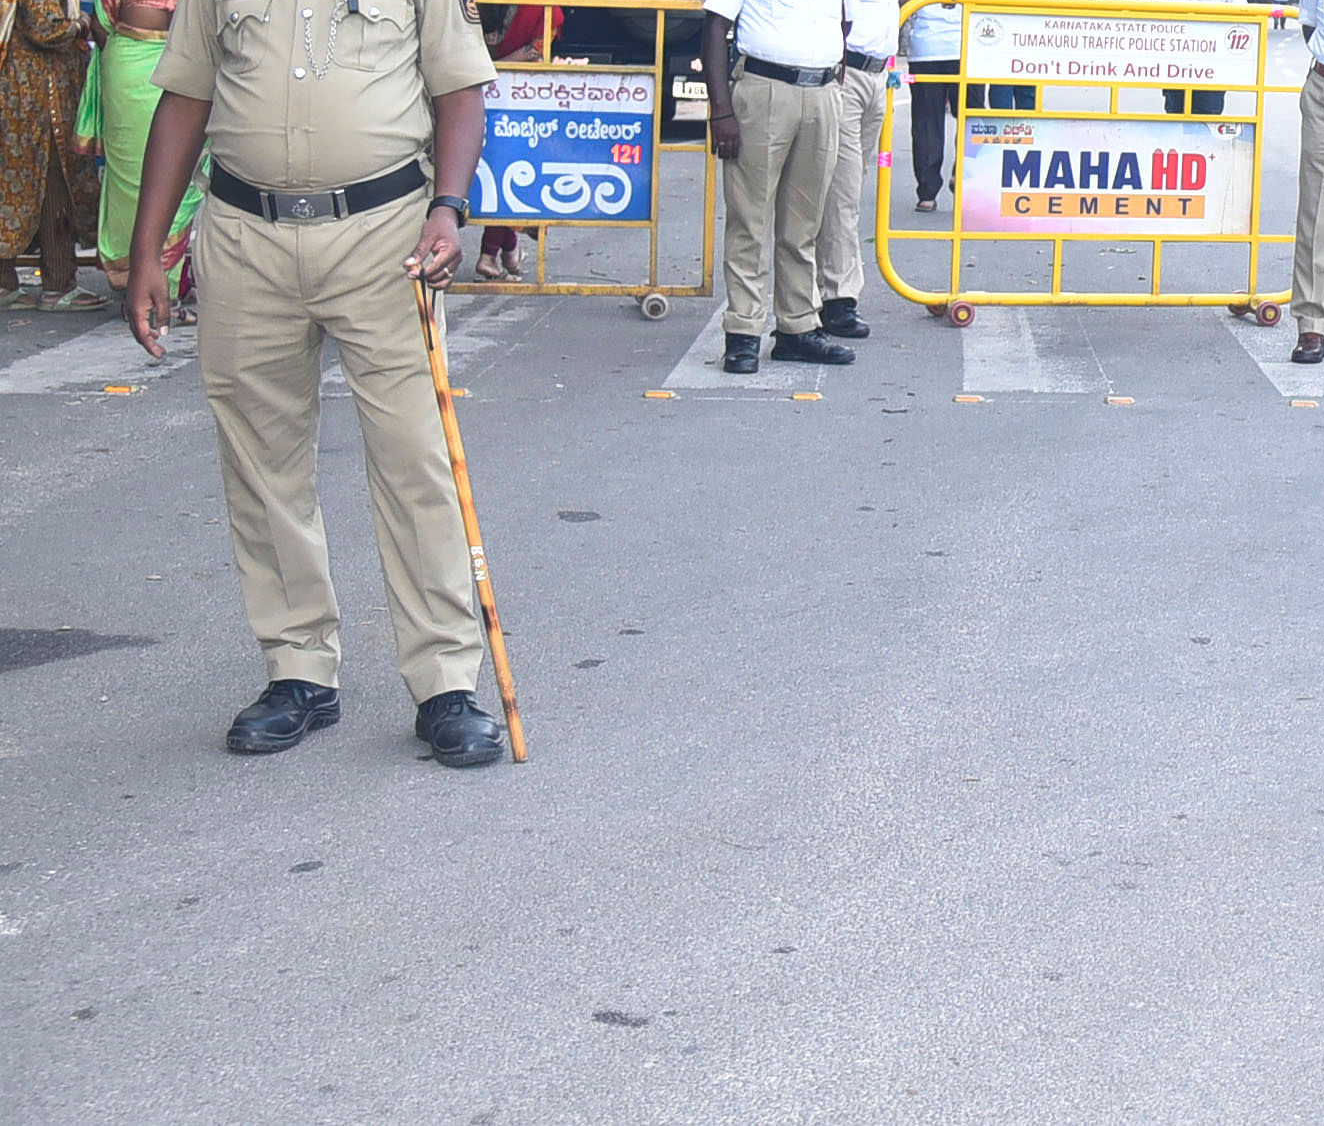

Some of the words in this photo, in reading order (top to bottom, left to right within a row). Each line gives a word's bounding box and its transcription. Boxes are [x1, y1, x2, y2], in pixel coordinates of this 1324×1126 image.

[1044, 20, 1111, 32] KARNATAKA
[1115, 23, 1147, 33] STATE
[1150, 24, 1186, 34] POLICE
[1012, 33, 1078, 49] TUMAKURU
[1082, 35, 1126, 50] TRAFFIC
[1128, 37, 1166, 51] POLICE
[1169, 38, 1217, 53] STATION
[1011, 58, 1061, 75] Don't
[1068, 61, 1117, 77] Drink
[1123, 63, 1160, 78] And
[1167, 64, 1215, 80] Drive
[610, 143, 642, 164] 121
[1001, 149, 1143, 190] MAHA
[1014, 196, 1192, 215] CEMENT
